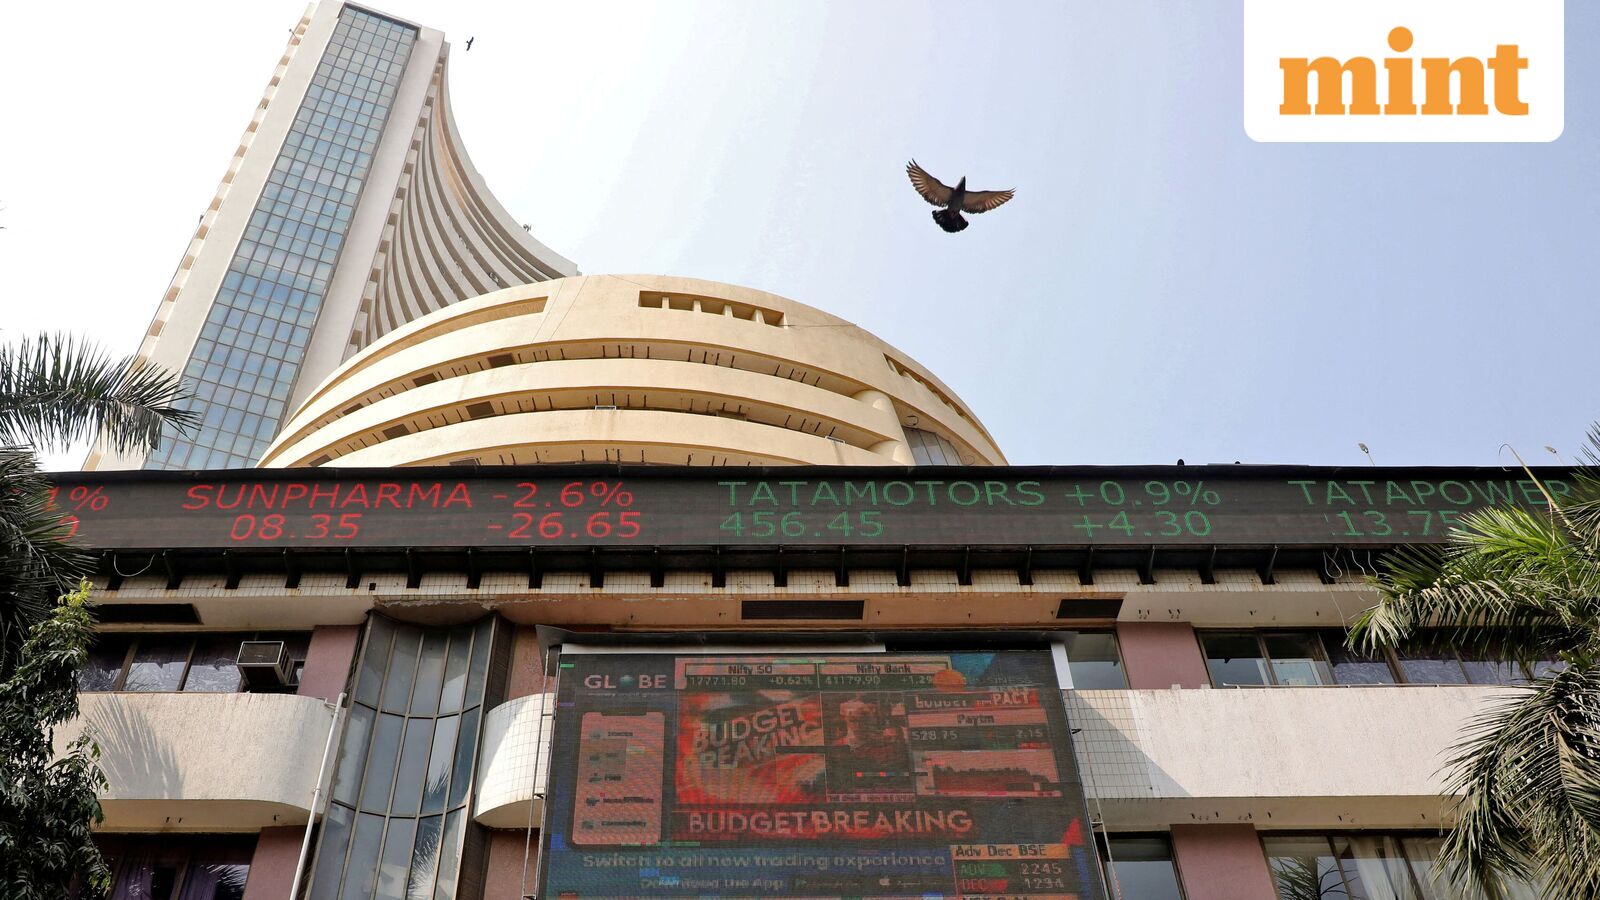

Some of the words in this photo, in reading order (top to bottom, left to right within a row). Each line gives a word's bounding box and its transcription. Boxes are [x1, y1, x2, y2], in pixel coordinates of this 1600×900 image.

[181, 482, 473, 511] SUNPHARMA
[493, 481, 635, 509] -2.6%
[718, 480, 1047, 507] TATAMOTORS
[1065, 480, 1222, 507] +0.9%
[1287, 480, 1571, 507] TATAPOWER
[230, 513, 363, 541] 08.35
[487, 511, 641, 540] -26.65
[718, 511, 885, 538] 456.45
[1073, 510, 1213, 538] +4.30
[955, 845, 981, 857] Adv
[987, 845, 1013, 857] Dec
[1018, 844, 1047, 856] BSE
